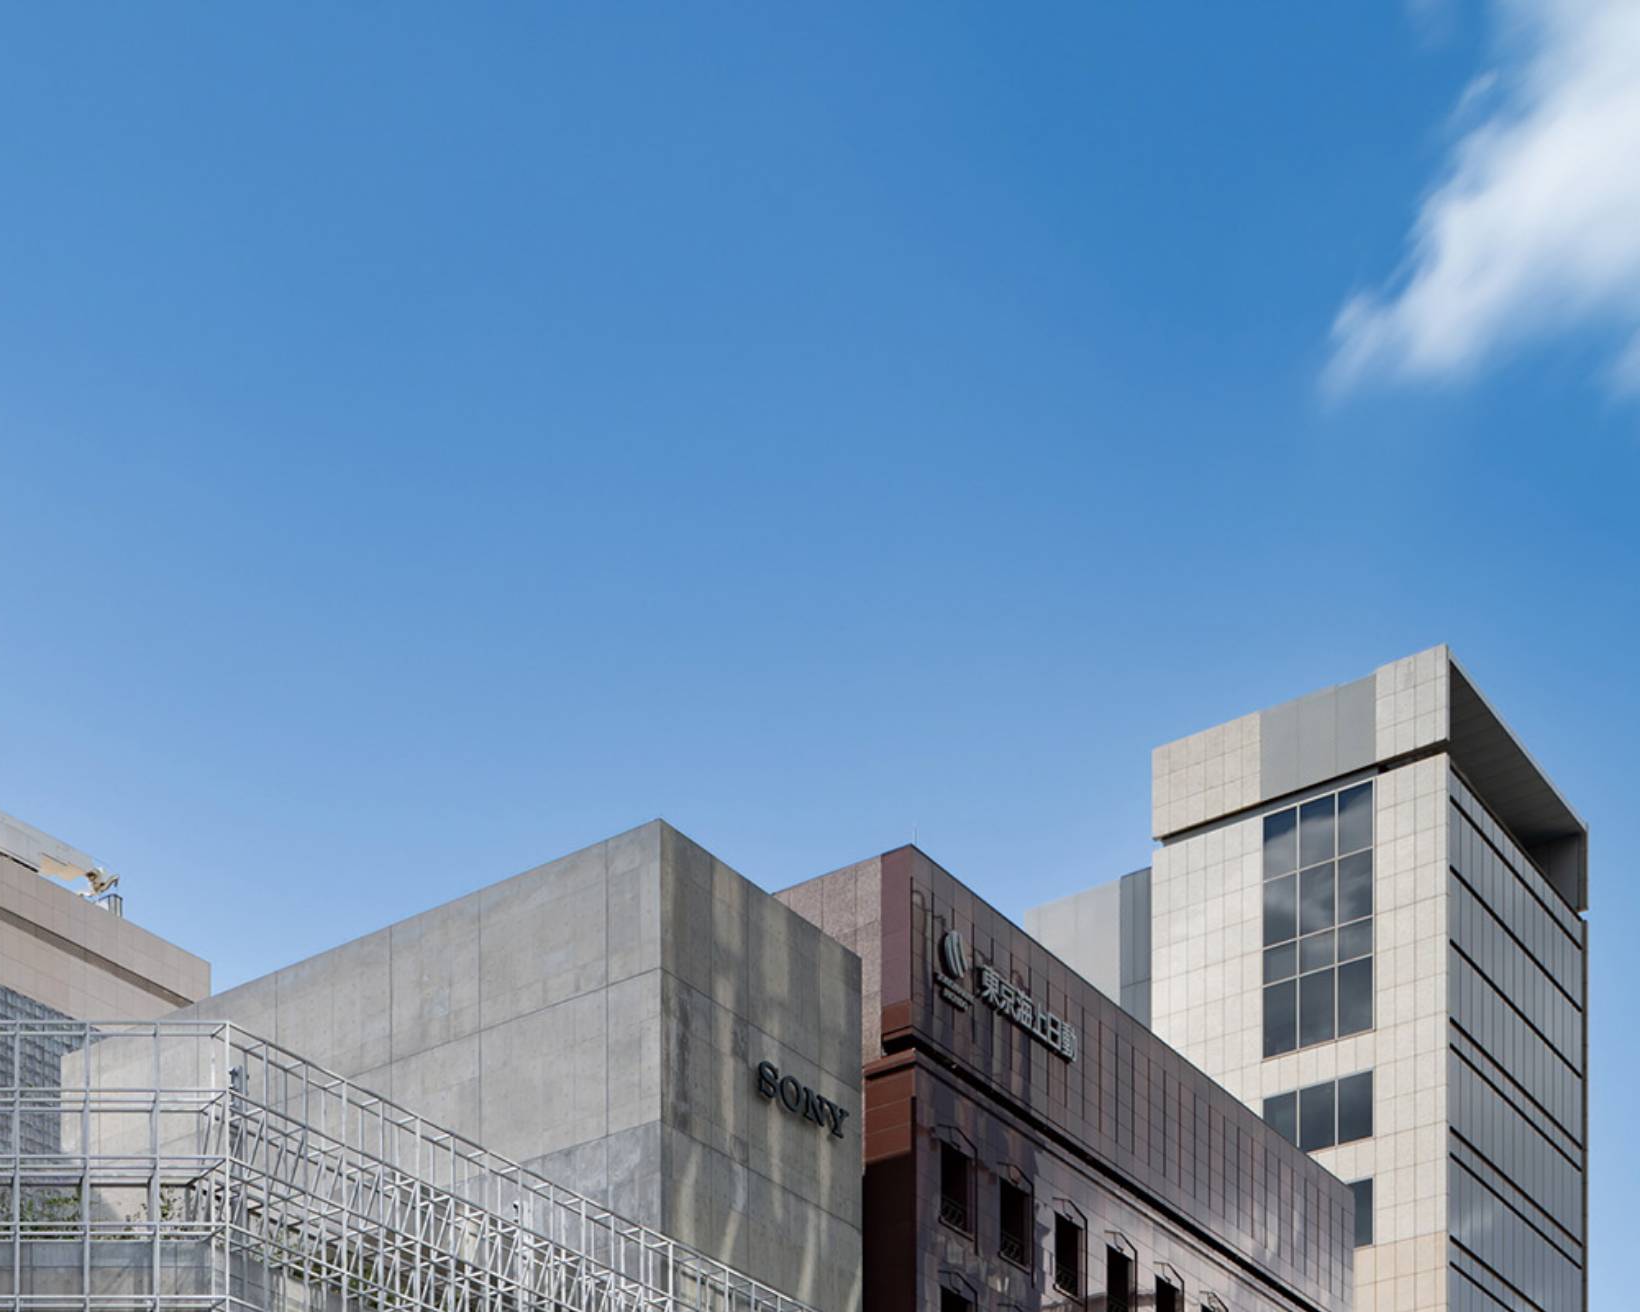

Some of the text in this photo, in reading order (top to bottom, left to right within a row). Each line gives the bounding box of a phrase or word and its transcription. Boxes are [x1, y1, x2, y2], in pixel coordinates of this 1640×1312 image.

[981, 963, 1077, 1063] 東京海上日動
[758, 1060, 850, 1139] SONY
